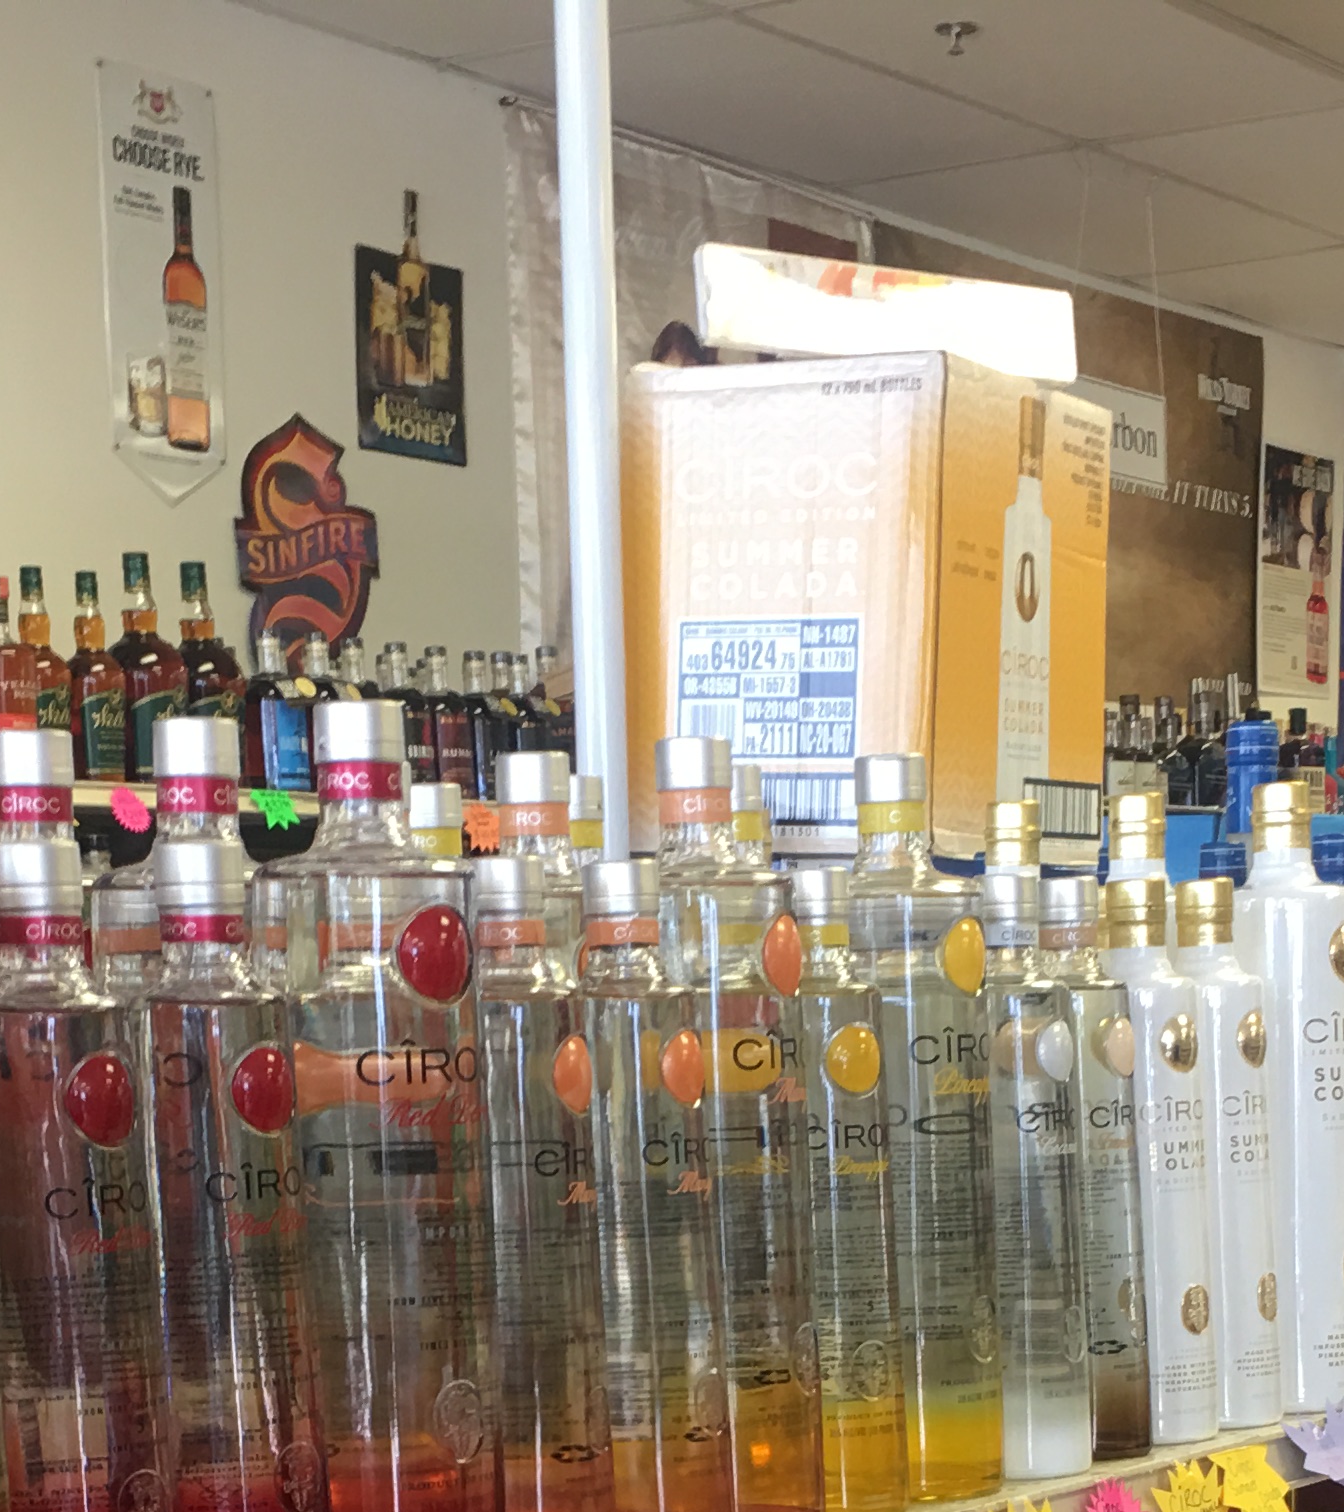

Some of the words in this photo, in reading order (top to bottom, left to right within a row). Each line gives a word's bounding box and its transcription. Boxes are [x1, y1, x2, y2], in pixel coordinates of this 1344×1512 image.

[112, 134, 172, 174] CHOOSE
[385, 418, 454, 446] HONEY
[1111, 411, 1158, 459] rbon
[246, 521, 369, 574] SINFIRE
[691, 536, 859, 568] SUMMER
[711, 638, 777, 671] 64924
[368, 1096, 435, 1131] Red
